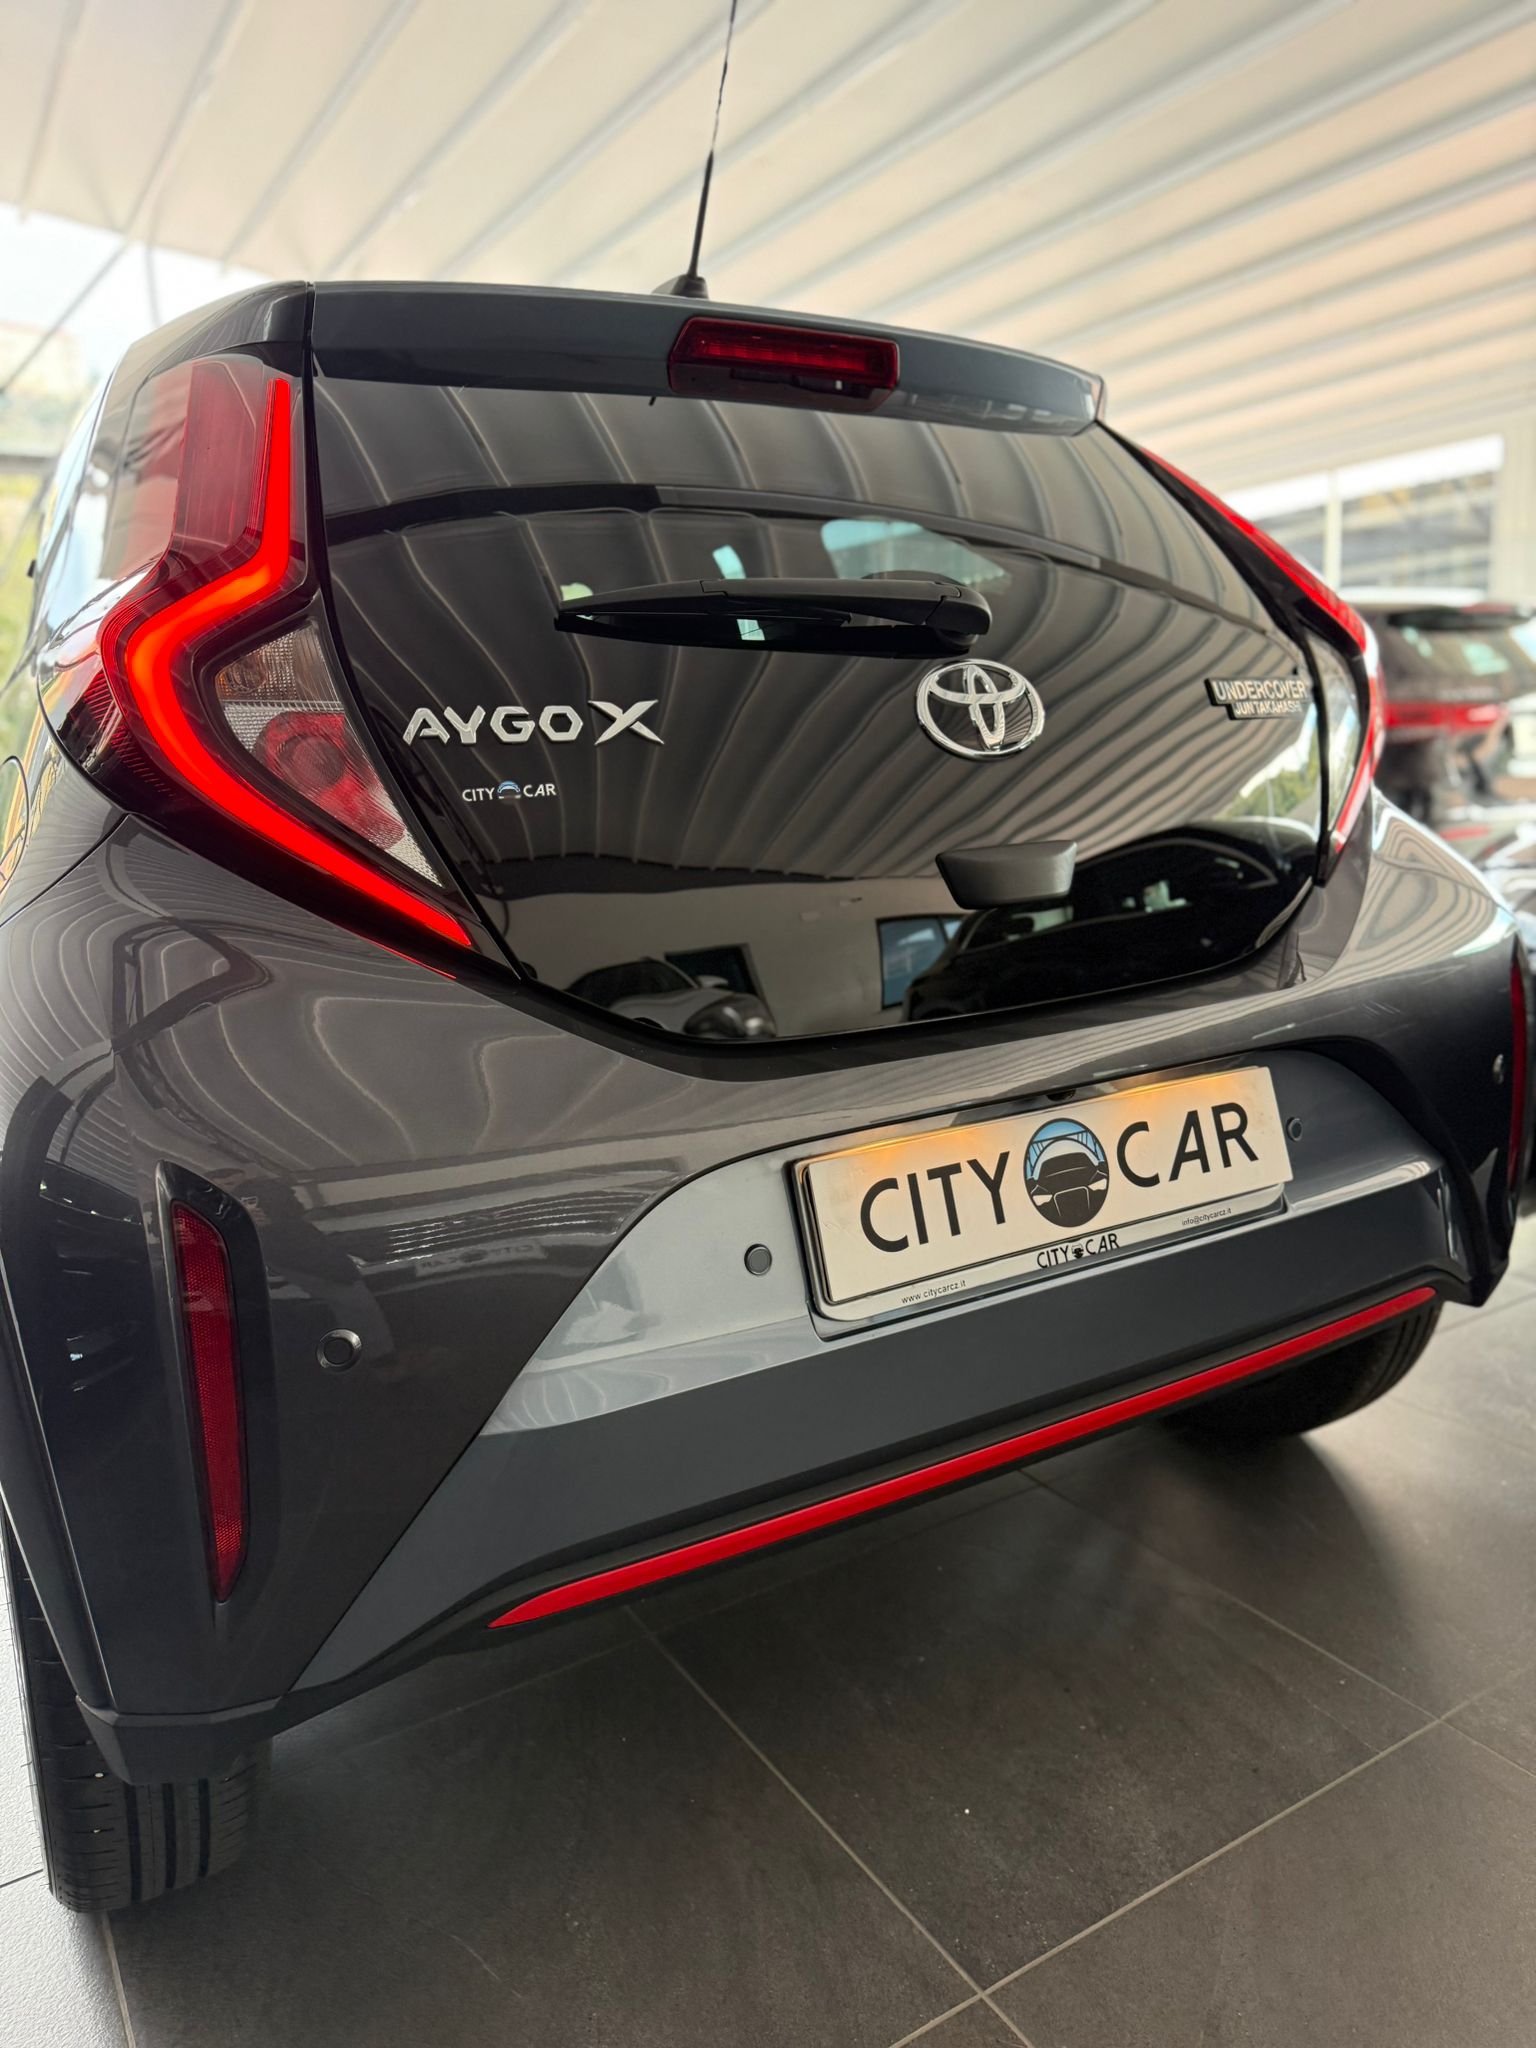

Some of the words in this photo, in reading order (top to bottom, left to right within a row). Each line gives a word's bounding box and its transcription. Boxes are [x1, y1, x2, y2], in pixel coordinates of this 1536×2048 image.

[1212, 679, 1307, 700] UNDERCOVER
[402, 705, 584, 746] AYGO
[587, 699, 665, 746] X
[462, 786, 495, 802] CITY
[522, 783, 557, 798] CAR
[860, 1150, 1011, 1253] CITY
[1116, 1102, 1259, 1188] CAR
[1036, 1245, 1069, 1269] CITY
[1085, 1233, 1120, 1256] CAR
